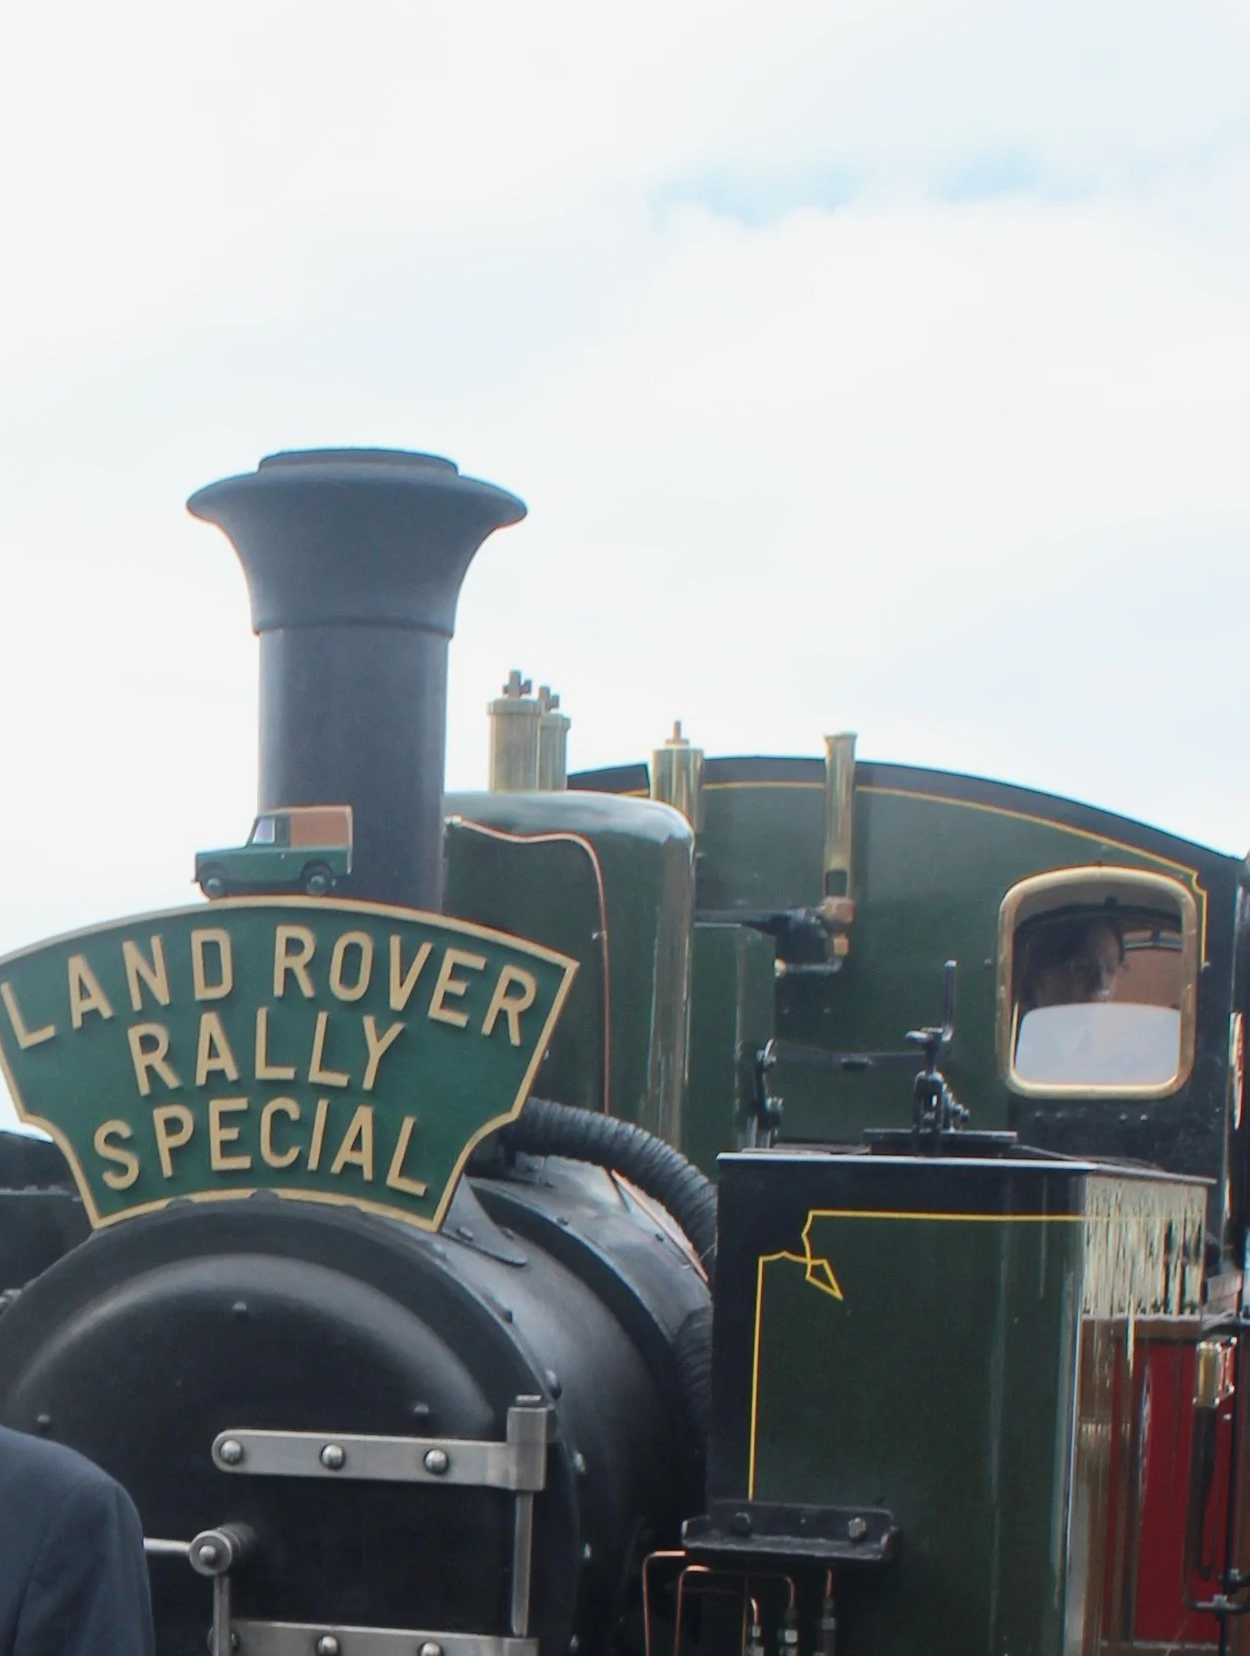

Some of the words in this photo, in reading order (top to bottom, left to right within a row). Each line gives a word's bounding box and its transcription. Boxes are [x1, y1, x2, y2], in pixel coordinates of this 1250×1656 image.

[0, 927, 235, 1050] LAND
[273, 924, 538, 1047] ROVER
[127, 1006, 405, 1097] RALLY
[92, 1097, 430, 1198] SPECIAL
